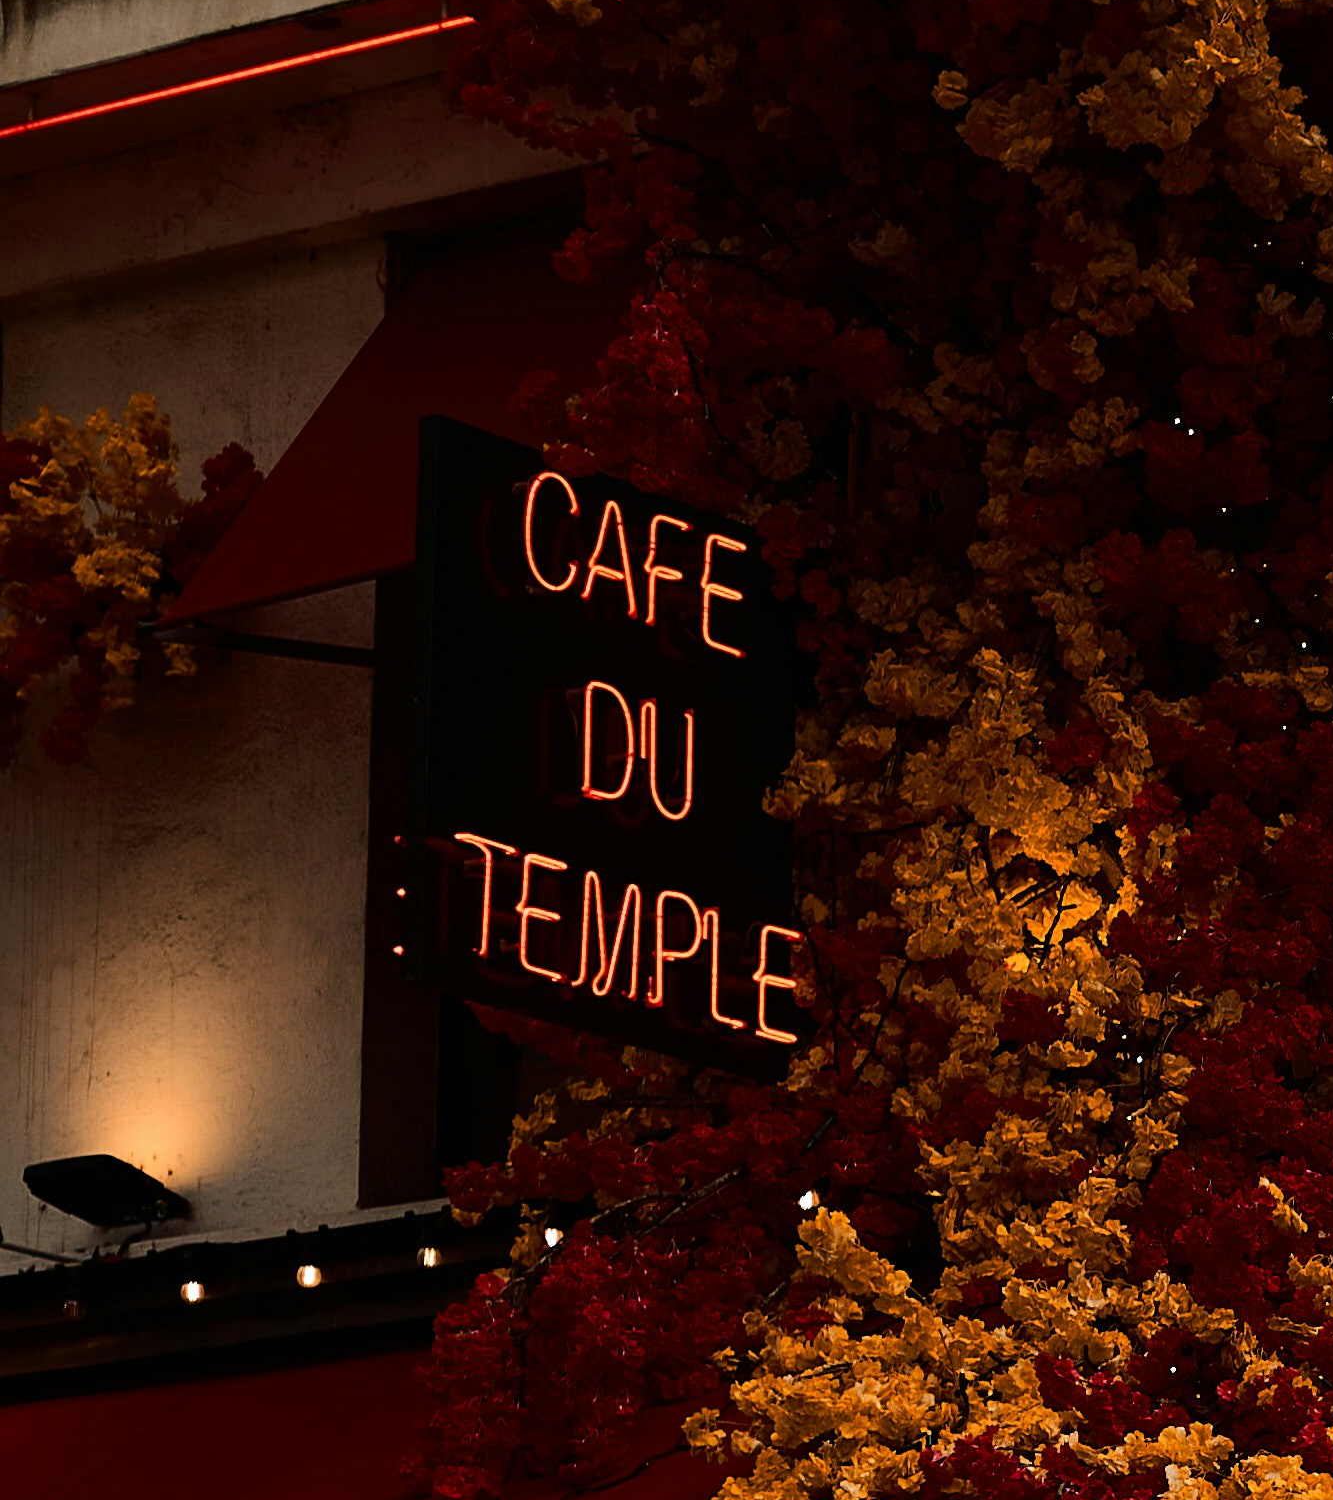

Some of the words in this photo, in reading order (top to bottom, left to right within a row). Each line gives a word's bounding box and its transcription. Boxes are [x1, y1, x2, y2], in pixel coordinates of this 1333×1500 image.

[524, 471, 749, 658] CAFE
[580, 679, 696, 821] DU
[454, 832, 805, 1044] TEMPLE
